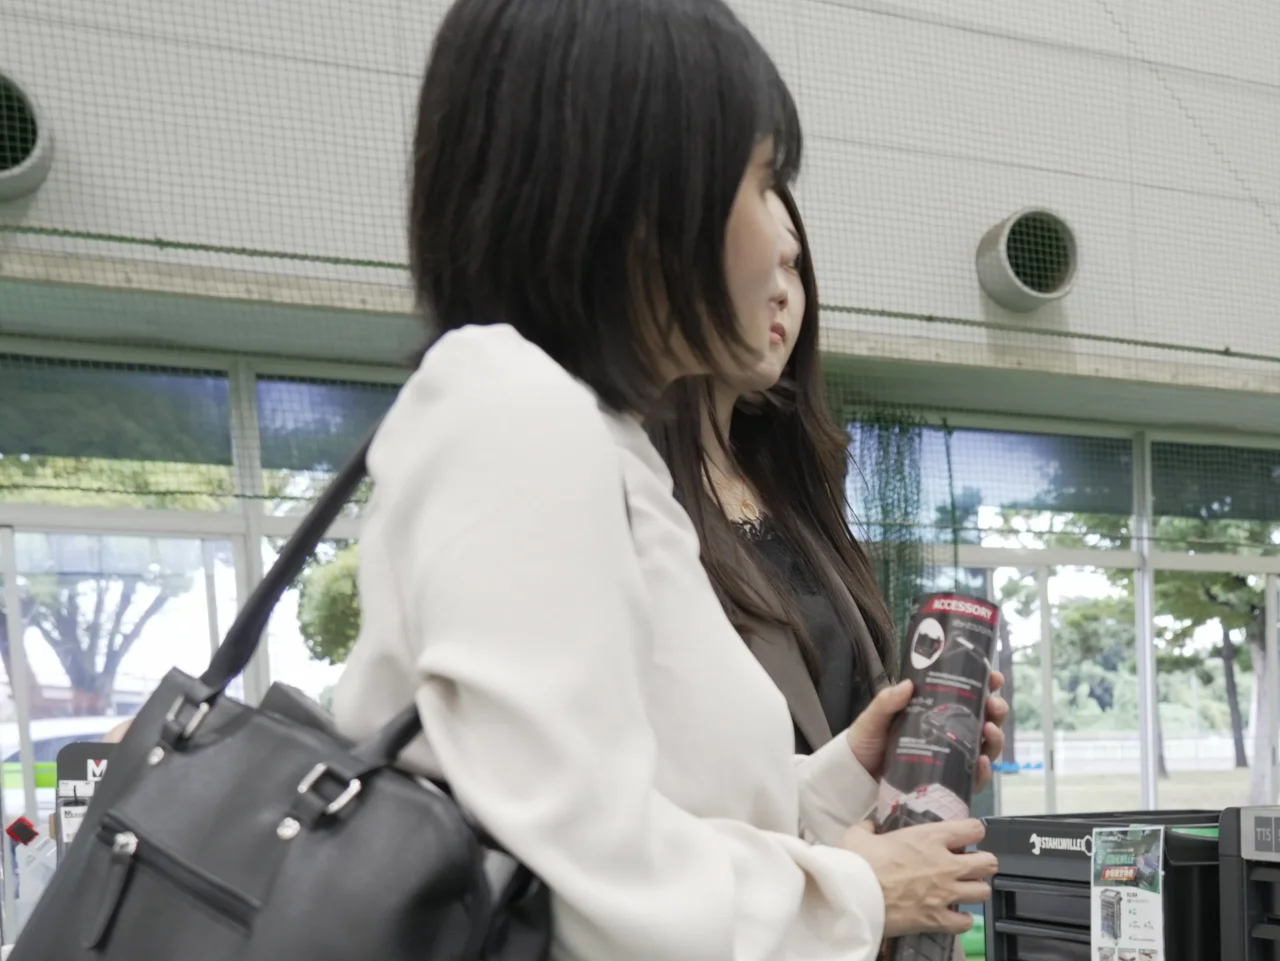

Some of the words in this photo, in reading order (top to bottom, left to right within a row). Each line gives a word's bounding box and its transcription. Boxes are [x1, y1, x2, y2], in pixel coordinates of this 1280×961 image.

[932, 599, 993, 620] ACCESSORY
[1256, 827, 1271, 842] TTS
[1041, 836, 1086, 851] STAHLWILLE
